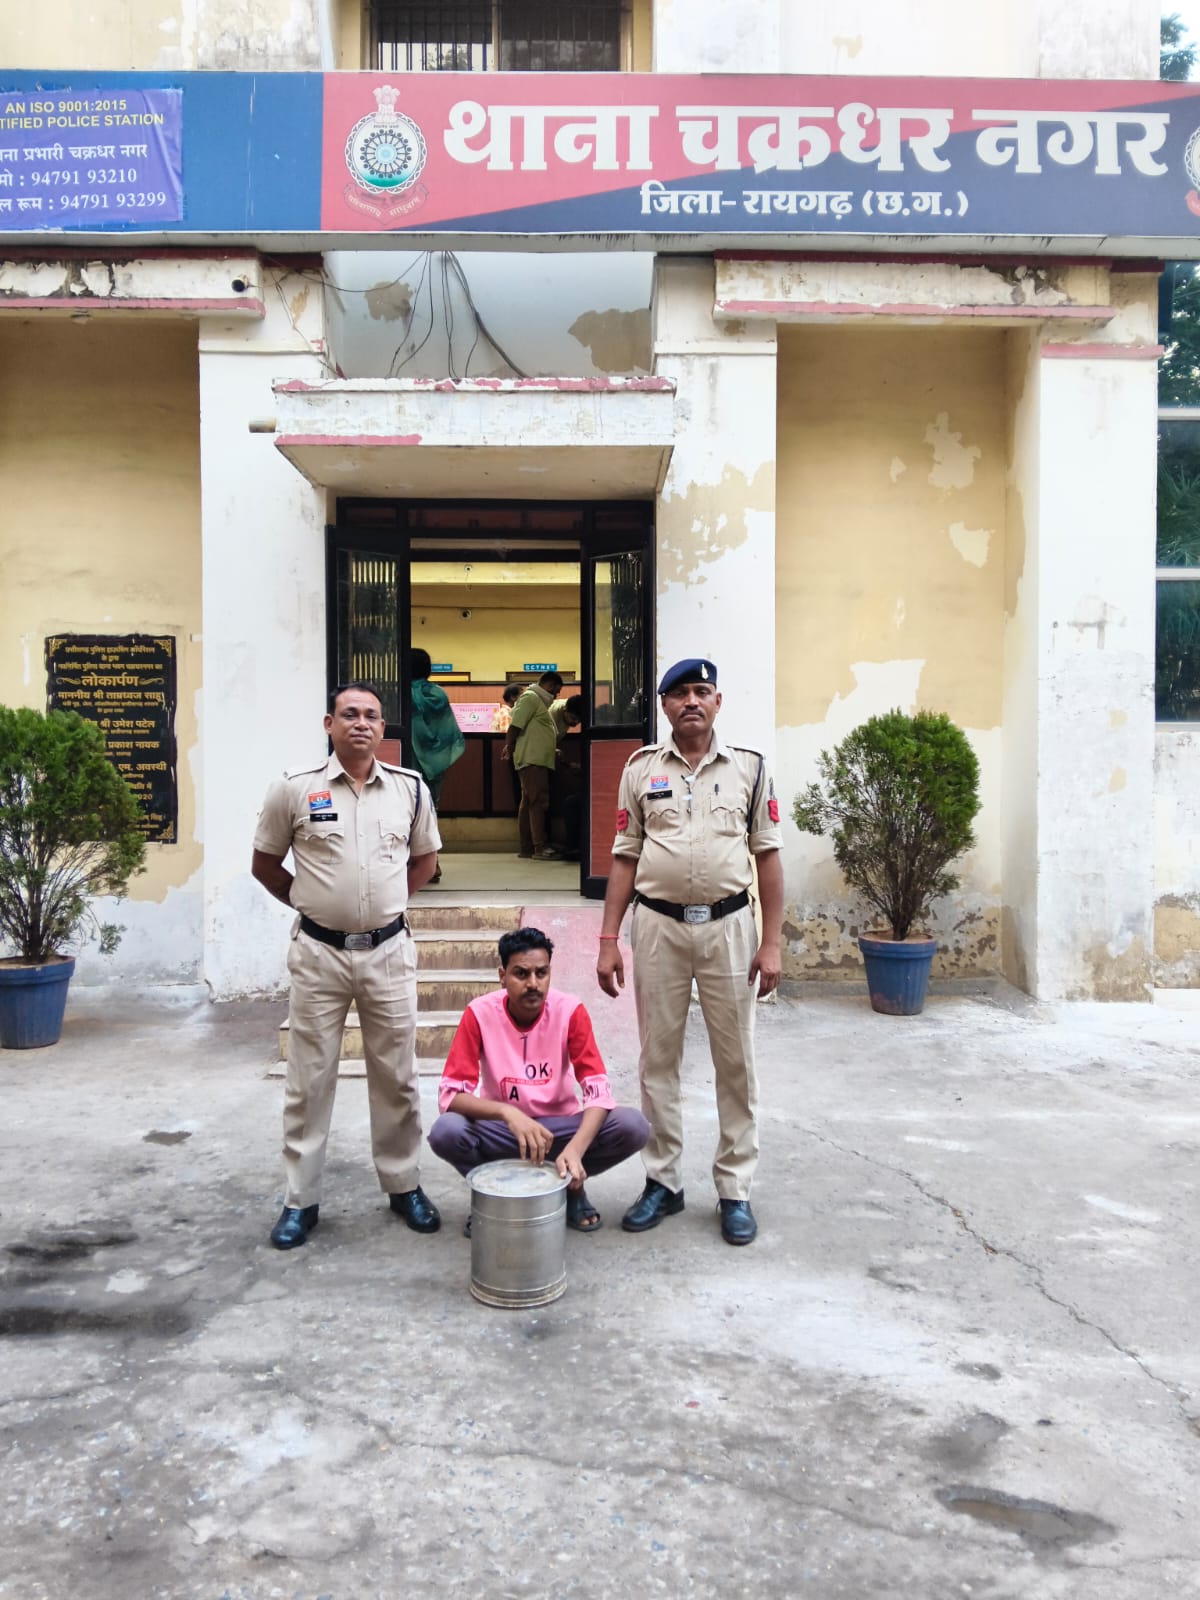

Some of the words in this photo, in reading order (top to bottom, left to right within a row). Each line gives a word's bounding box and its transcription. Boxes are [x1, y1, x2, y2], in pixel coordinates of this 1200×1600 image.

[5, 102, 25, 114] AN
[30, 101, 54, 113] ISO
[58, 100, 127, 112] 9001:2015
[47, 115, 100, 128] POLICE
[104, 113, 164, 126] STATION
[443, 100, 659, 171] थाना
[676, 102, 954, 174] चक्रधर
[972, 108, 1170, 176] नगर
[23, 142, 64, 161] प्रभारी
[68, 145, 116, 160] चक्रधर
[119, 144, 148, 158] नगर
[31, 170, 80, 186] 94791
[87, 168, 137, 184] 93210
[16, 197, 42, 211] रूम
[60, 193, 110, 210] 94791
[116, 191, 167, 208] 93299
[743, 190, 854, 220] रायगढ़
[81, 672, 139, 687] लोकार्पण
